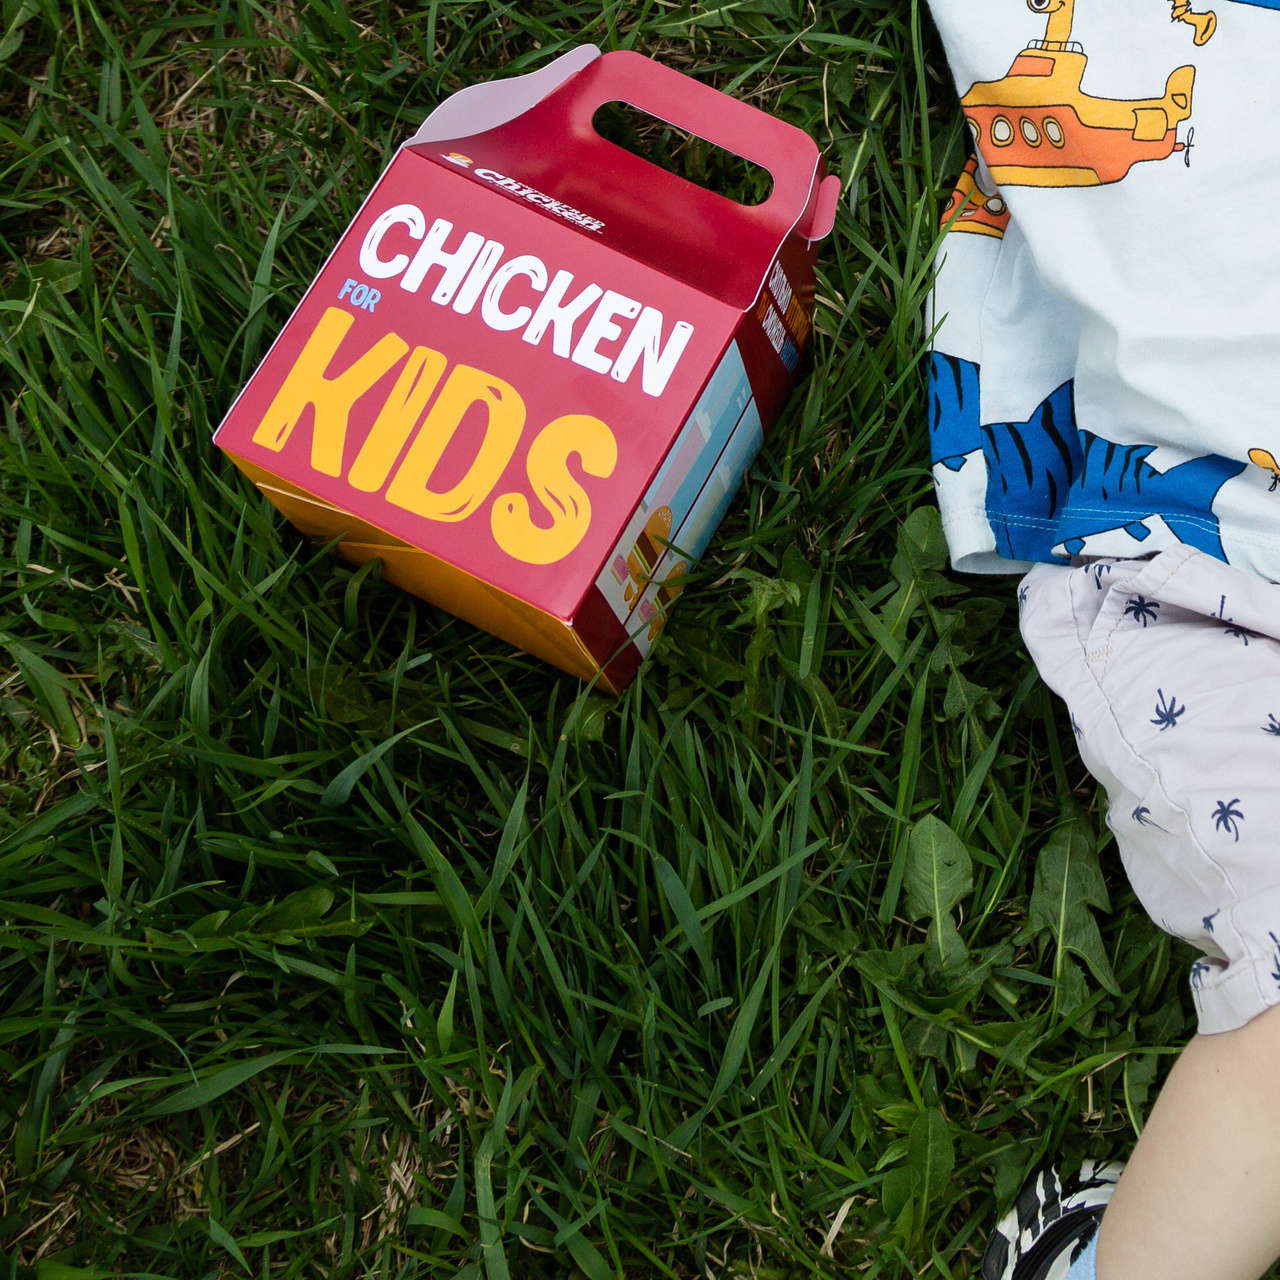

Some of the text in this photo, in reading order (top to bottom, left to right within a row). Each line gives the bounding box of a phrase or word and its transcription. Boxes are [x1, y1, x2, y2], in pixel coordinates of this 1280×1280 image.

[559, 204, 606, 227] FRIED
[337, 278, 382, 314] FOR
[358, 203, 695, 398] CHICKEN
[252, 307, 618, 566] KIDS
